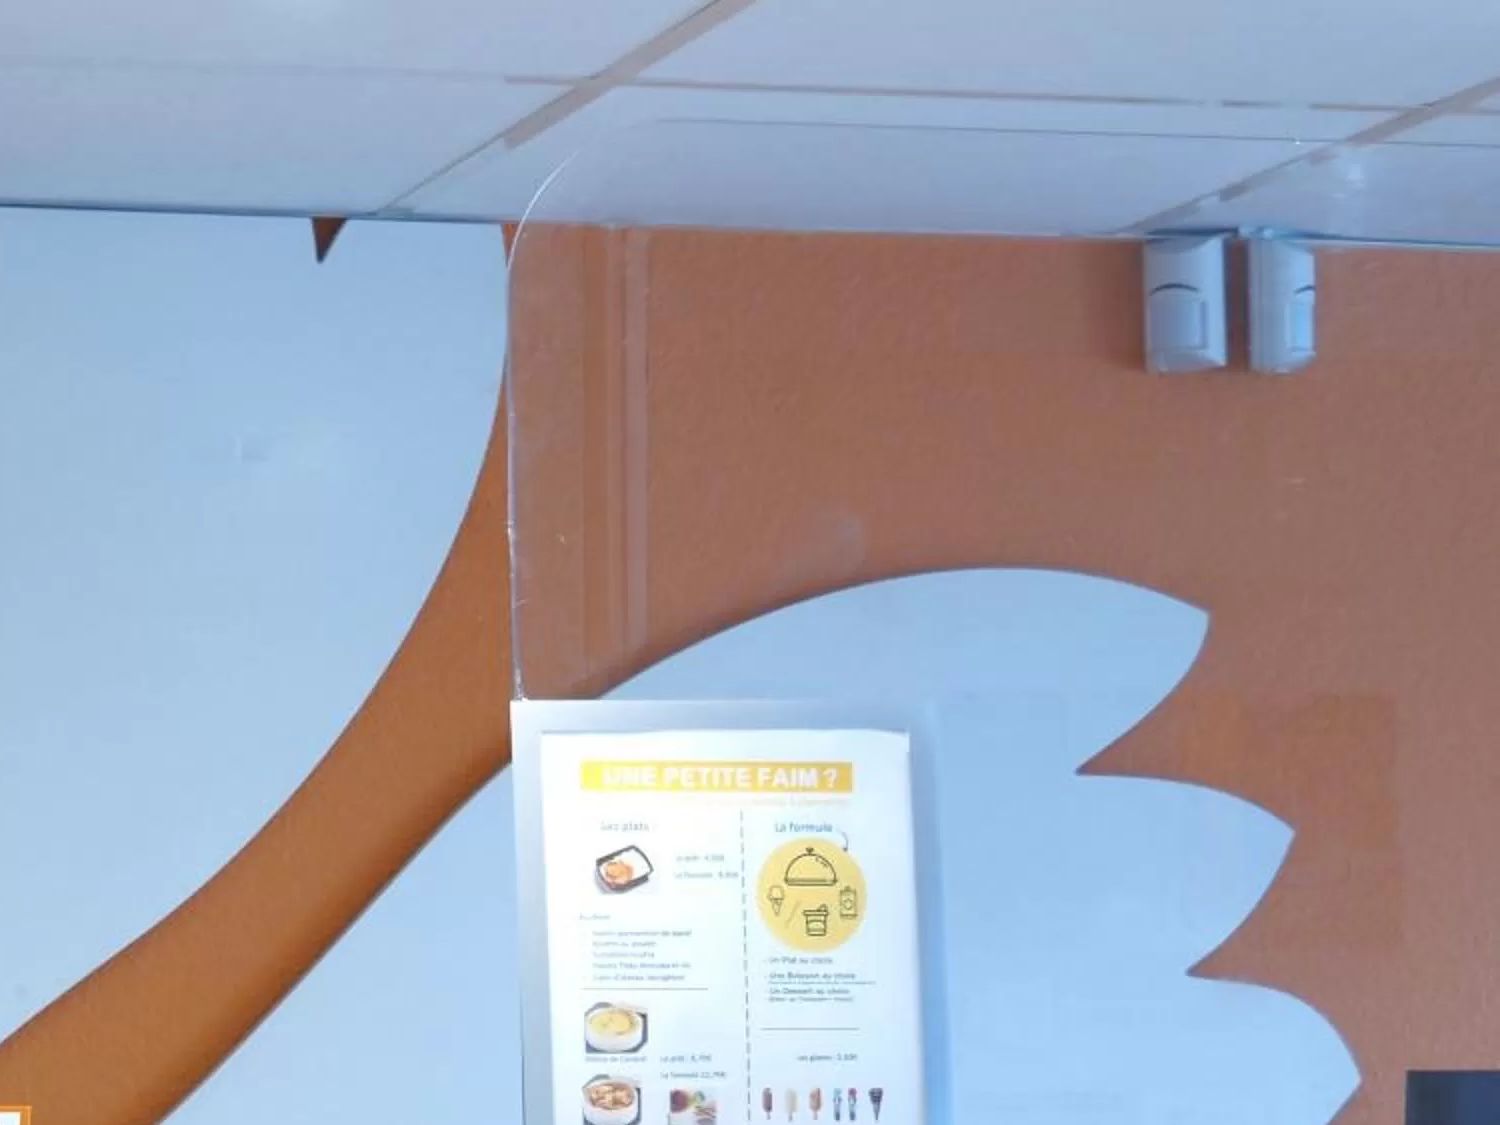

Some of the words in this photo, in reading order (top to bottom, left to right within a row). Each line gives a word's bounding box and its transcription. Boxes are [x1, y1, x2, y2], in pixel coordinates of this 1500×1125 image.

[603, 767, 656, 786] UNE
[664, 767, 753, 788] PETITE
[758, 768, 818, 789] FAIM
[823, 769, 837, 788] ?
